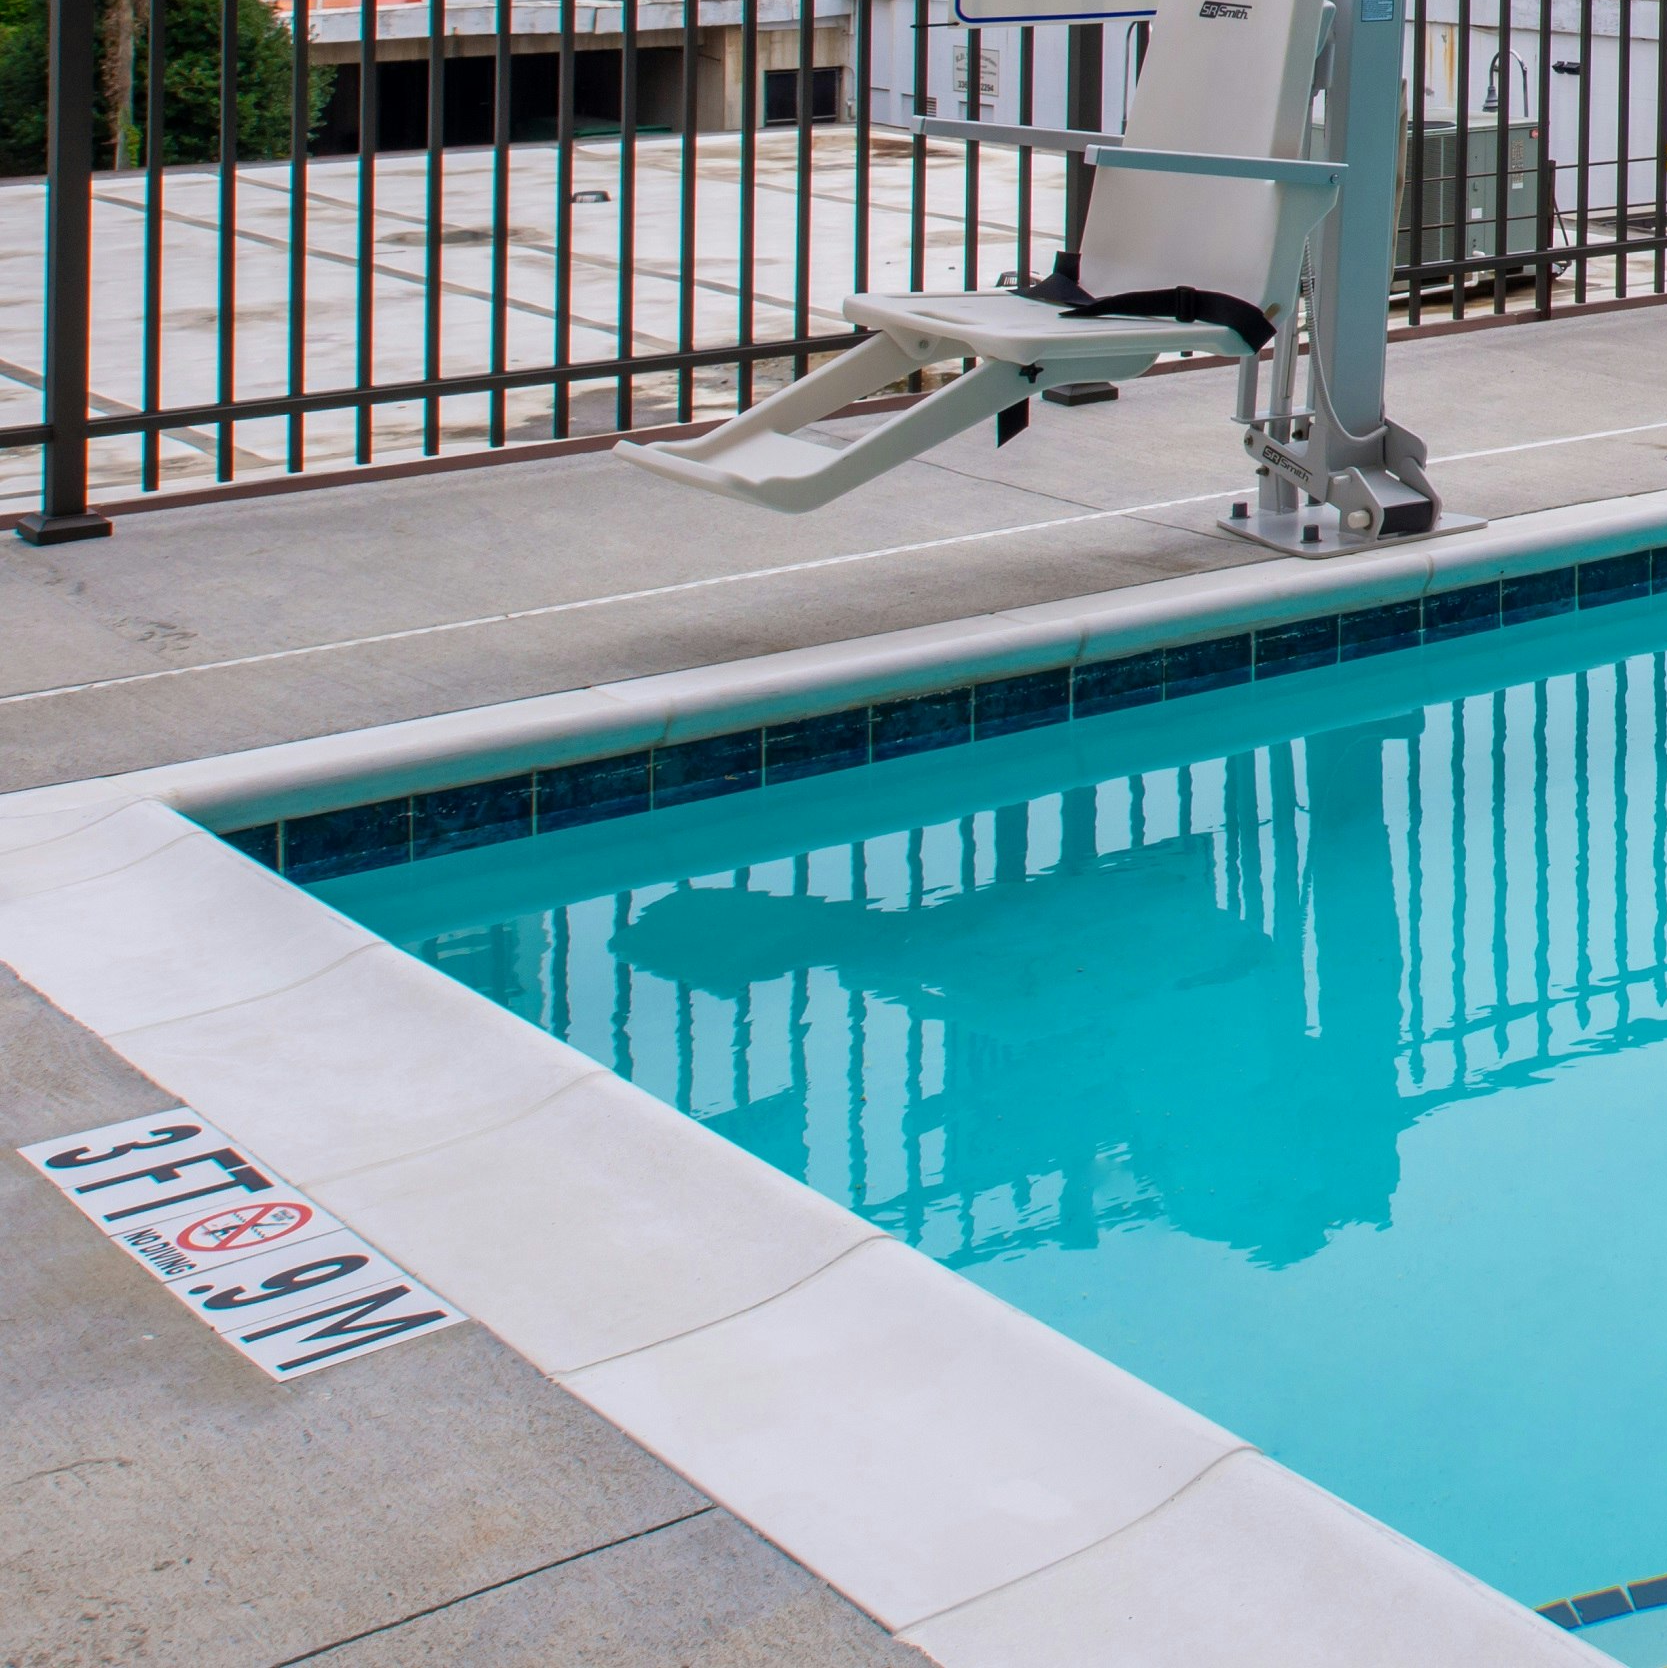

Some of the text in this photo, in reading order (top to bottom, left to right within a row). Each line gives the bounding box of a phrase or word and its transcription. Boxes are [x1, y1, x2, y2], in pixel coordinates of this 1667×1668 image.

[1218, 5, 1249, 20] Smith
[123, 1228, 197, 1275] NO DIVING
